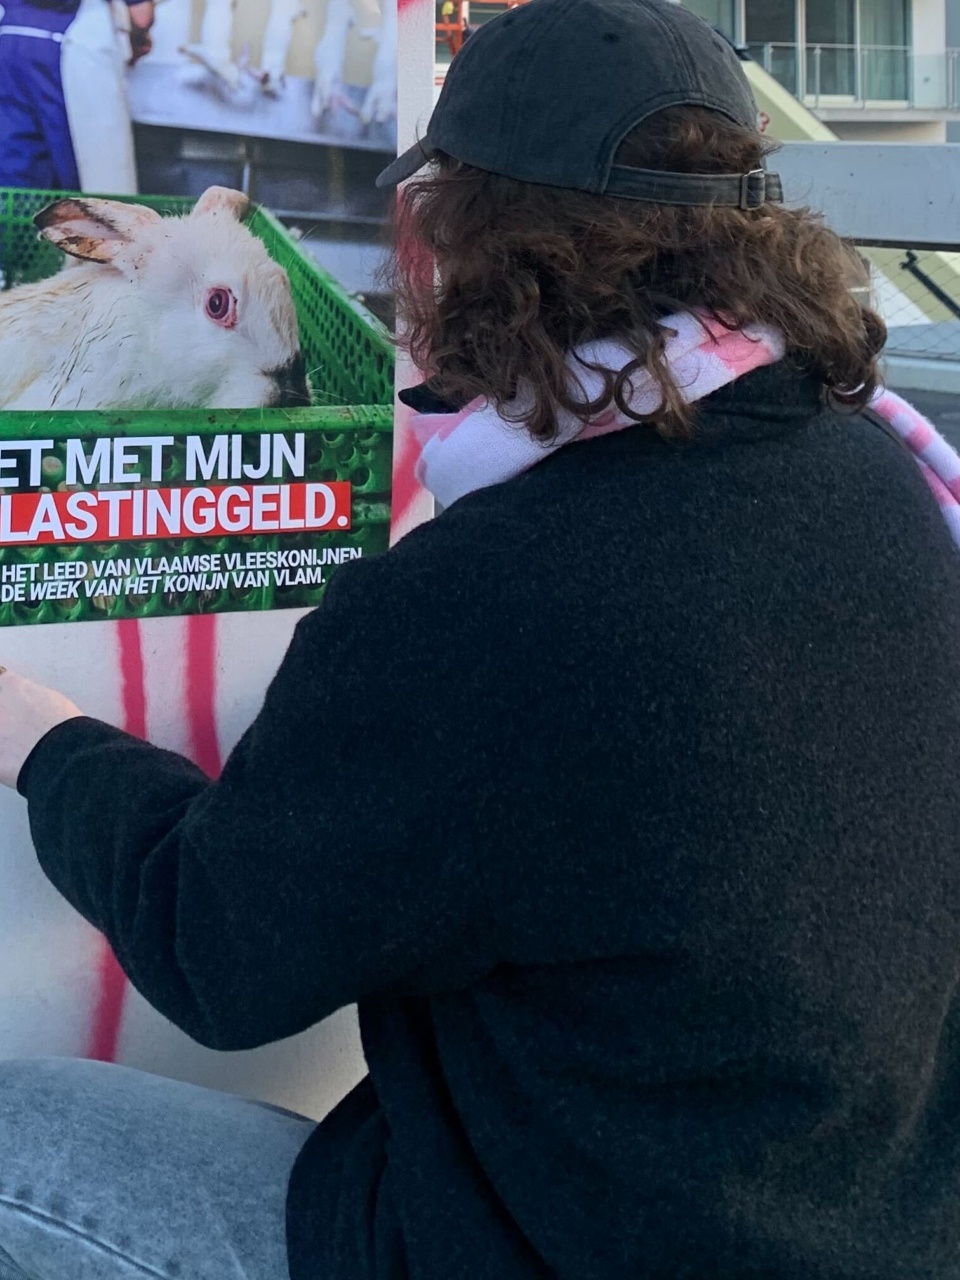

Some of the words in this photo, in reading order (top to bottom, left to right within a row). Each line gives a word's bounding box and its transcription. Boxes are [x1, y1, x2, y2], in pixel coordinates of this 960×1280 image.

[66, 437, 174, 485] MET
[185, 433, 306, 481] MIJN
[2, 563, 39, 583] HET
[43, 561, 88, 580] LEED
[92, 558, 131, 577] VAN
[135, 554, 221, 575] VLAAMSE
[224, 546, 363, 570] VLEESKONIJNEN
[1, 584, 26, 603] DE
[30, 580, 81, 600] WEEK
[85, 579, 122, 597] VAN
[124, 576, 162, 595] HET
[164, 572, 228, 593] KONIJN
[232, 570, 270, 589] VAN
[275, 567, 326, 587] VLAM.
